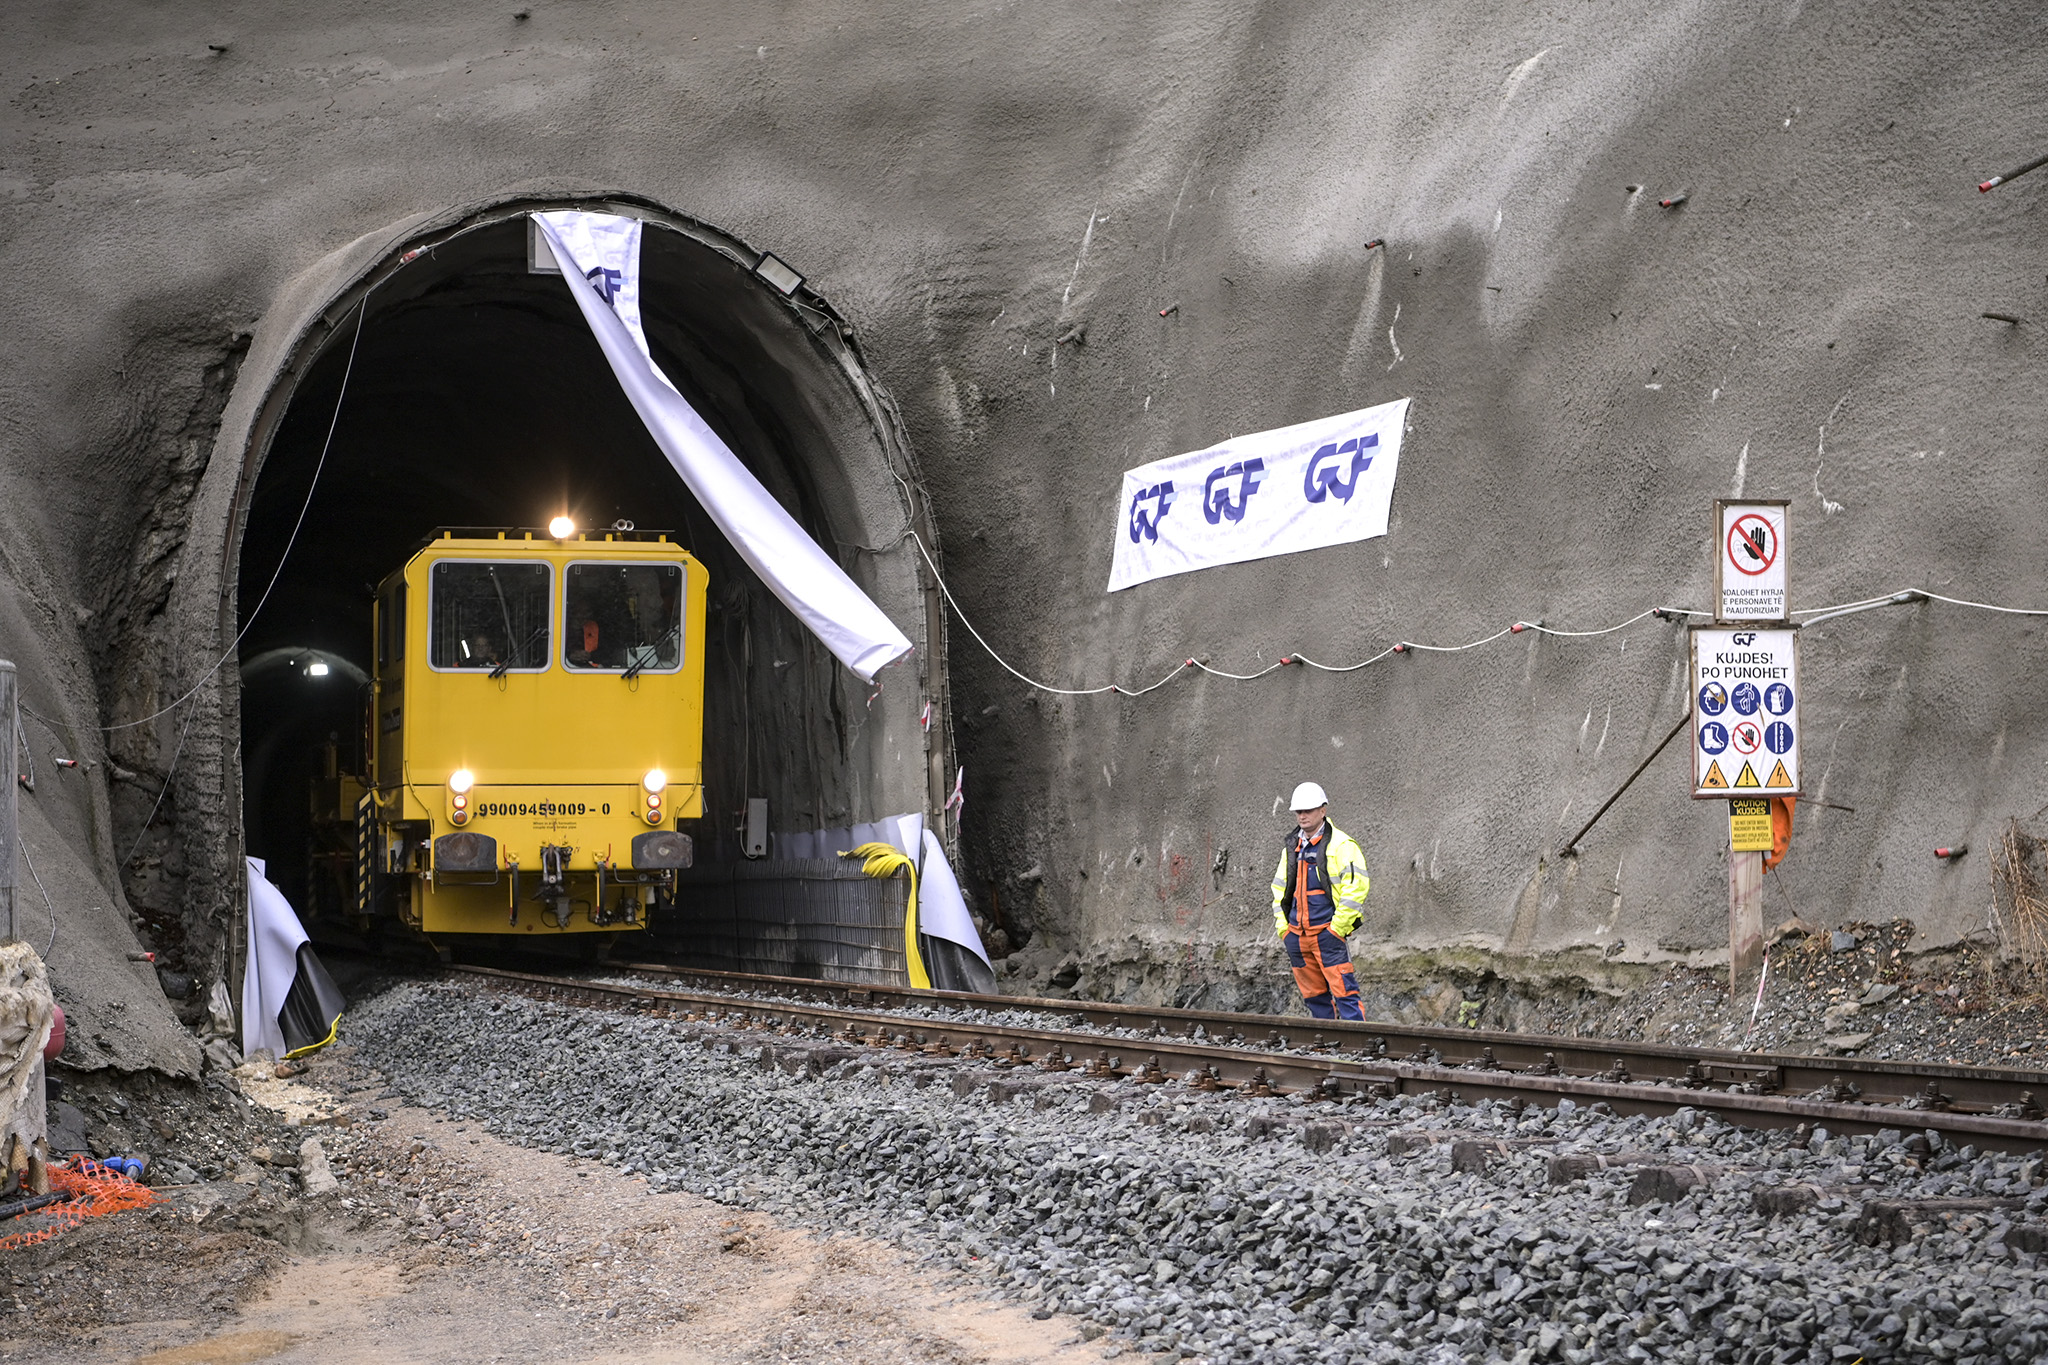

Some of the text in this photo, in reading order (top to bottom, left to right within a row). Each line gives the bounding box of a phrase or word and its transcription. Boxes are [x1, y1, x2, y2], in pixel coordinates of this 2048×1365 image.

[1203, 457, 1266, 527] GCF
[1303, 432, 1380, 506] GCF
[1761, 588, 1784, 596] HYRJA
[1729, 597, 1773, 605] PERSONAVE
[1725, 606, 1780, 614] PAAUTORIZUAR
[1732, 632, 1757, 647] GCF
[1716, 652, 1773, 664] KUJDES!
[1701, 667, 1789, 679] PO PUNOHET
[1736, 807, 1766, 815] KUJDES
